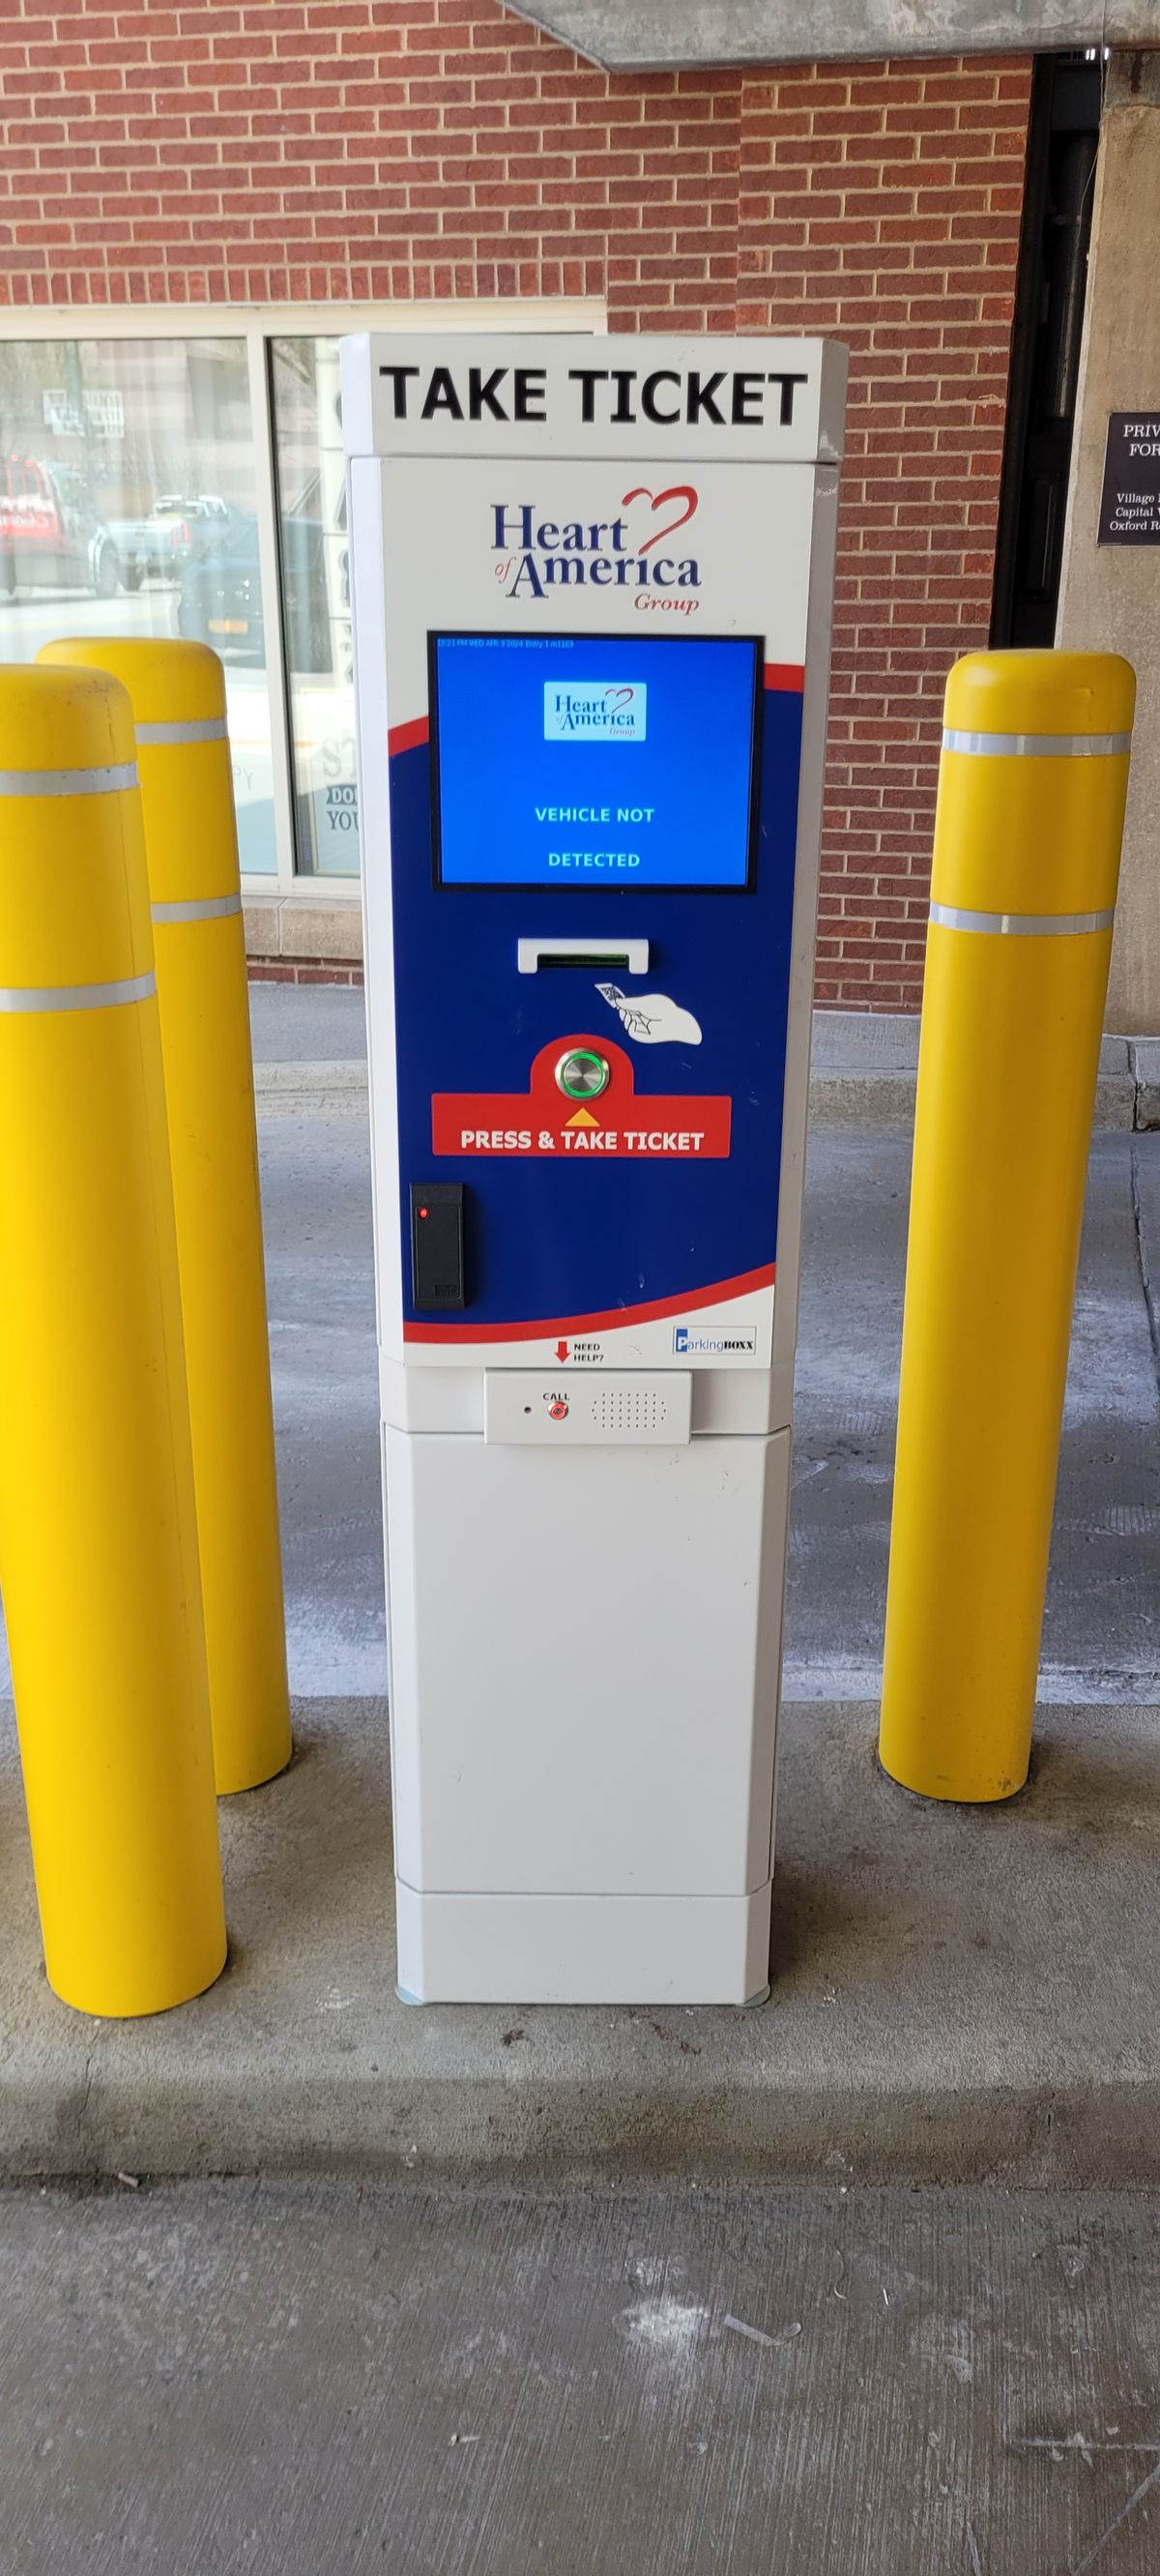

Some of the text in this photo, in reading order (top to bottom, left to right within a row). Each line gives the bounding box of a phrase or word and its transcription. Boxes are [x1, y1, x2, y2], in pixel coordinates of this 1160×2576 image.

[378, 366, 809, 426] TAKE TICKET
[1116, 493, 1155, 506] Village
[1116, 507, 1153, 519] Capital
[490, 504, 629, 551] Heart
[1110, 520, 1147, 531] Oxford
[495, 552, 702, 599] of America
[634, 593, 700, 616] Group
[555, 694, 607, 713] Heart
[561, 713, 635, 731] America
[535, 806, 655, 823] VEHICLE NOT
[548, 852, 640, 867] DETECTED
[461, 1130, 705, 1152] PRESS & TAKE TICKET
[573, 1343, 600, 1352] NEED
[678, 1336, 754, 1353] ParkingBOXX
[573, 1354, 604, 1362] HELP?
[542, 1392, 570, 1401] CALL
